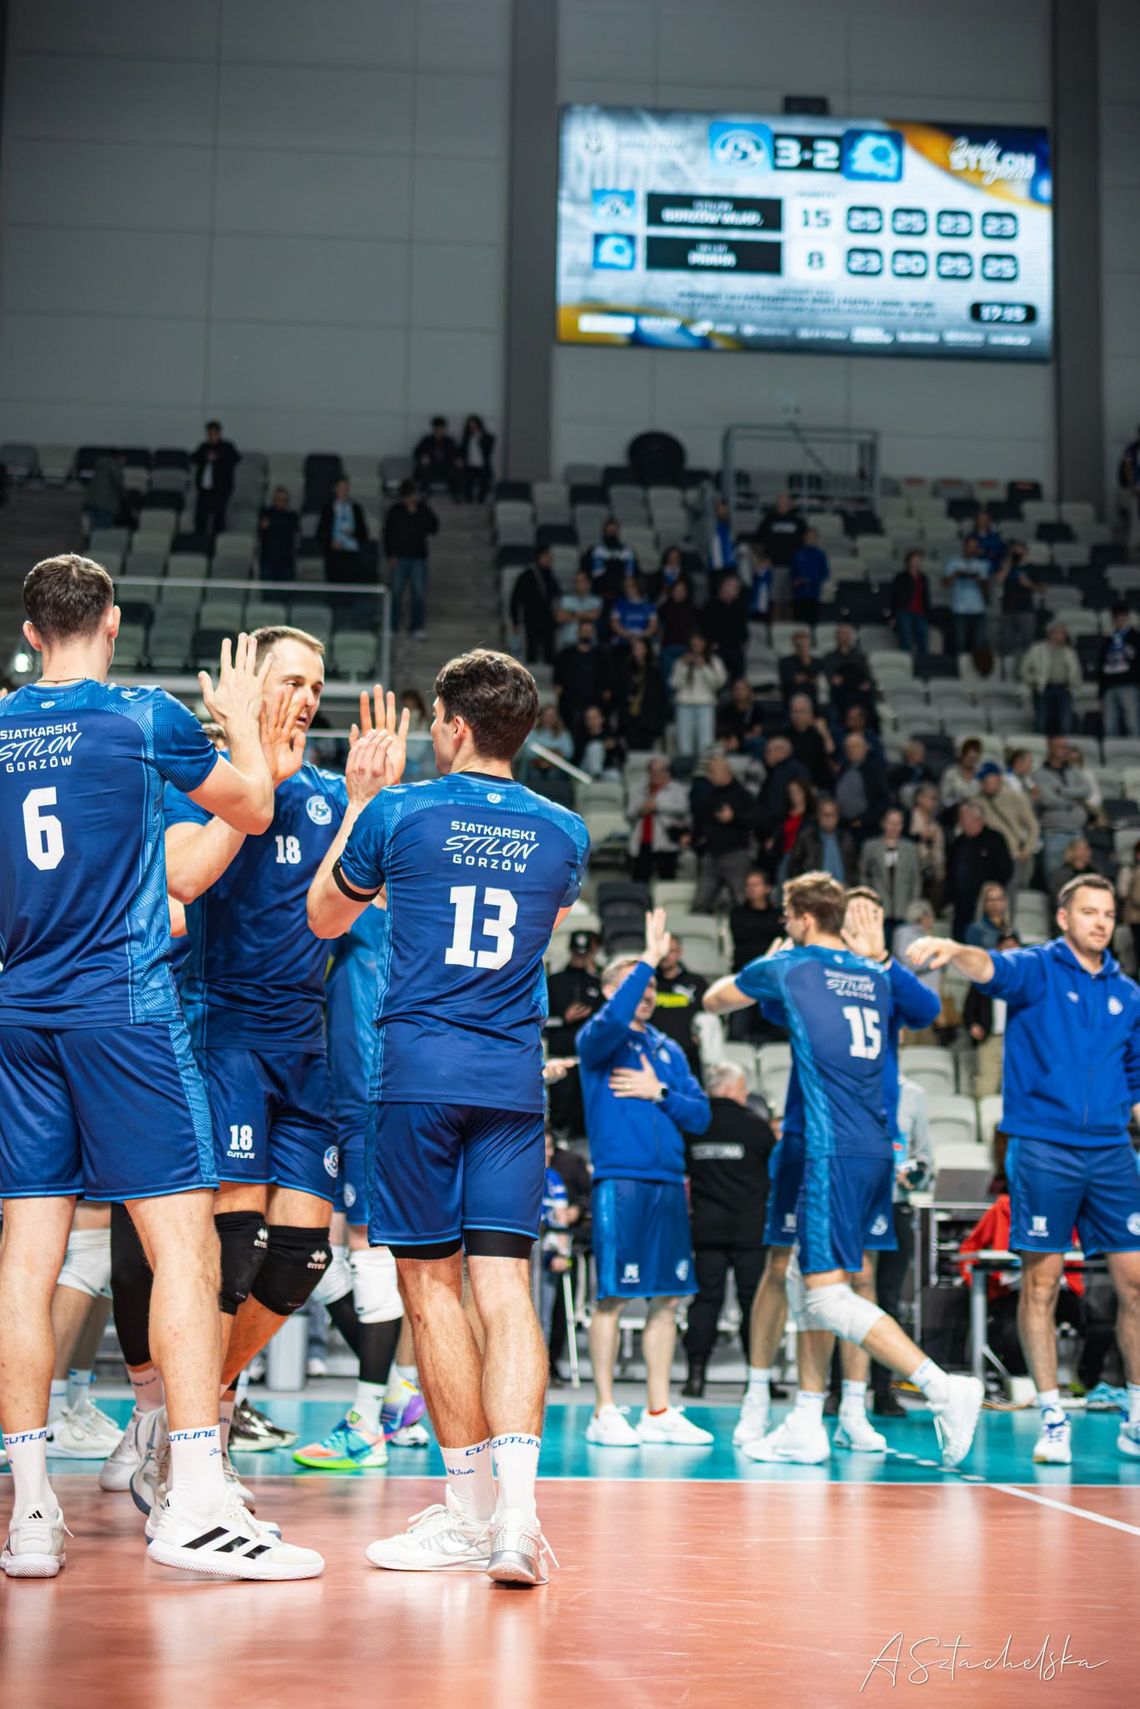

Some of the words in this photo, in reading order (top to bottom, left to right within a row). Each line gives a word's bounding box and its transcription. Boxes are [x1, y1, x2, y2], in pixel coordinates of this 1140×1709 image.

[802, 208, 831, 228] 15
[851, 209, 880, 231] 25
[895, 211, 924, 233] 25
[851, 252, 880, 273] 23
[895, 254, 924, 275] 20
[0, 722, 78, 740] SIATKARSKI
[0, 732, 82, 762] STILON
[6, 755, 73, 773] GORZÓW
[22, 786, 65, 871] 6
[450, 820, 537, 842] SIATKARSKI
[275, 835, 302, 865] 18
[442, 835, 540, 860] STILON
[452, 853, 527, 874] GORZÓW
[444, 885, 518, 971] 13
[842, 1005, 882, 1060] 15
[229, 1124, 253, 1151] 18
[168, 1429, 216, 1442] UTLINE
